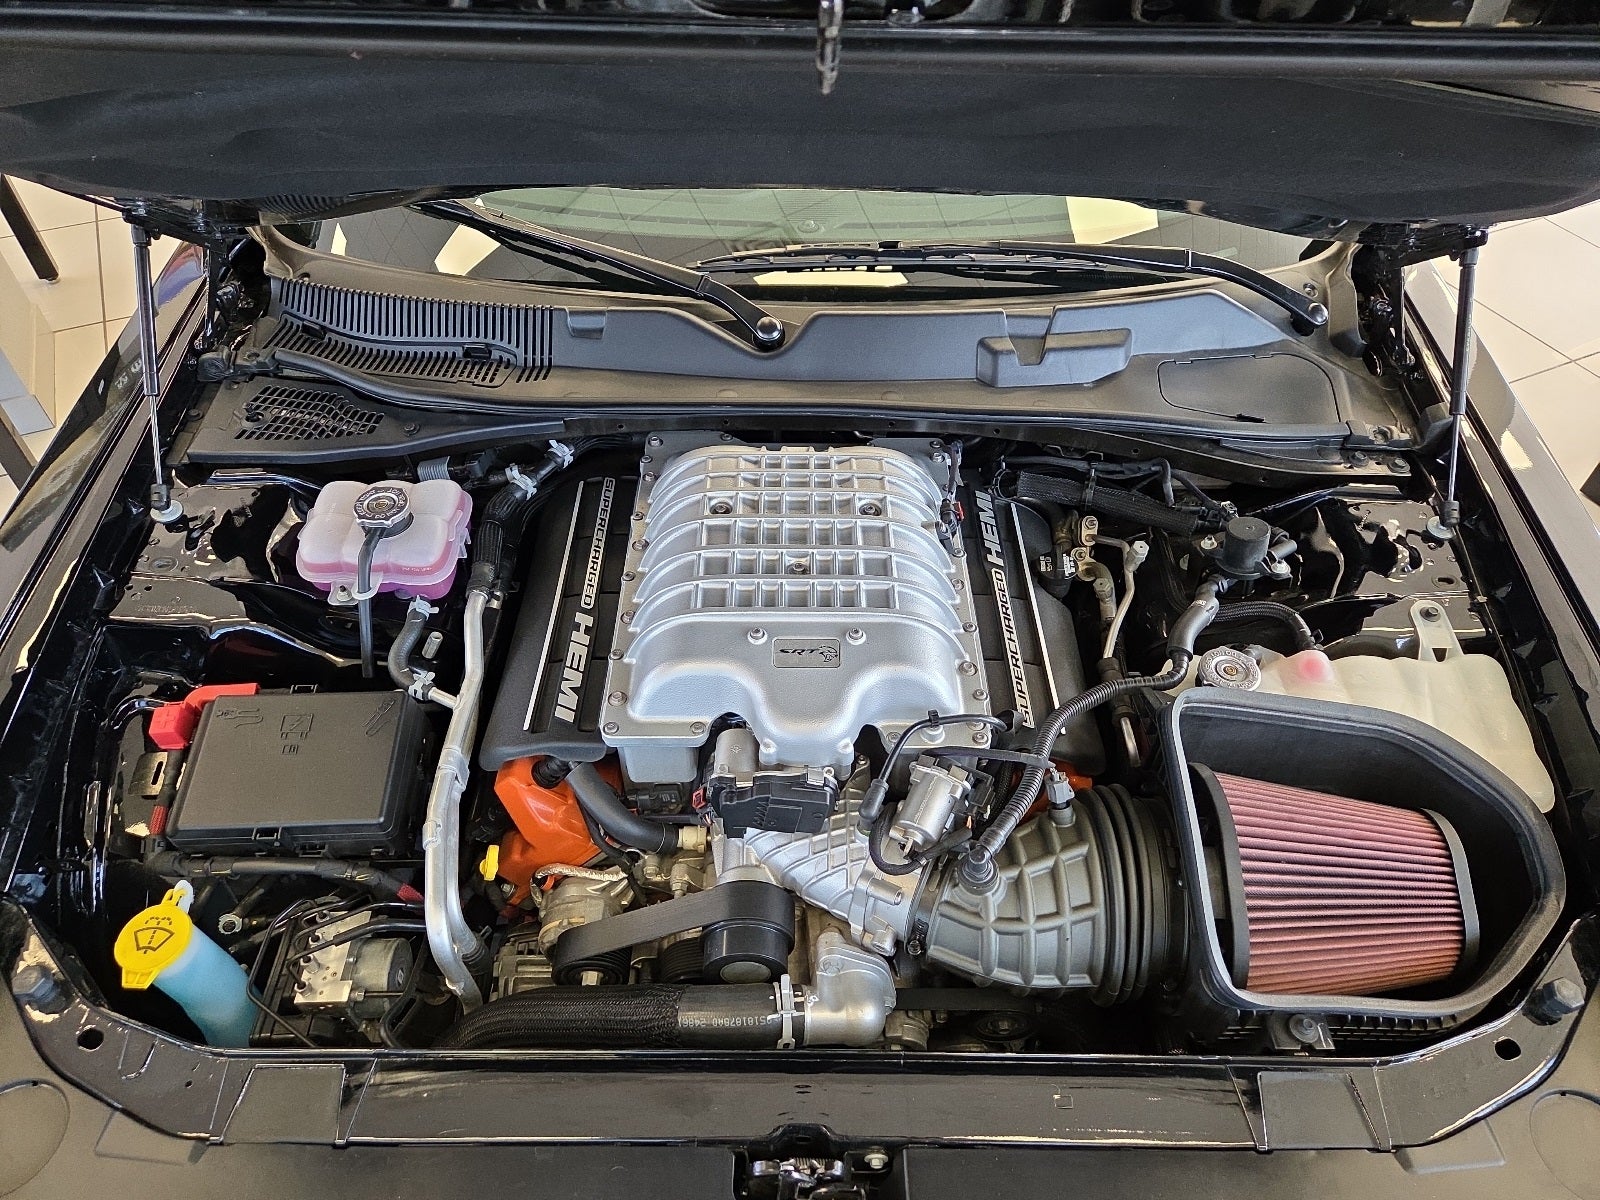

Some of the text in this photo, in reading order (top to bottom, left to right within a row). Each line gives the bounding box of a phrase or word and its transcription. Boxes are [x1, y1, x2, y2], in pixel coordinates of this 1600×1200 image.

[554, 477, 616, 723] SUPERCHARGED HEMI
[975, 490, 1035, 729] SUPERCHARGED HEMI
